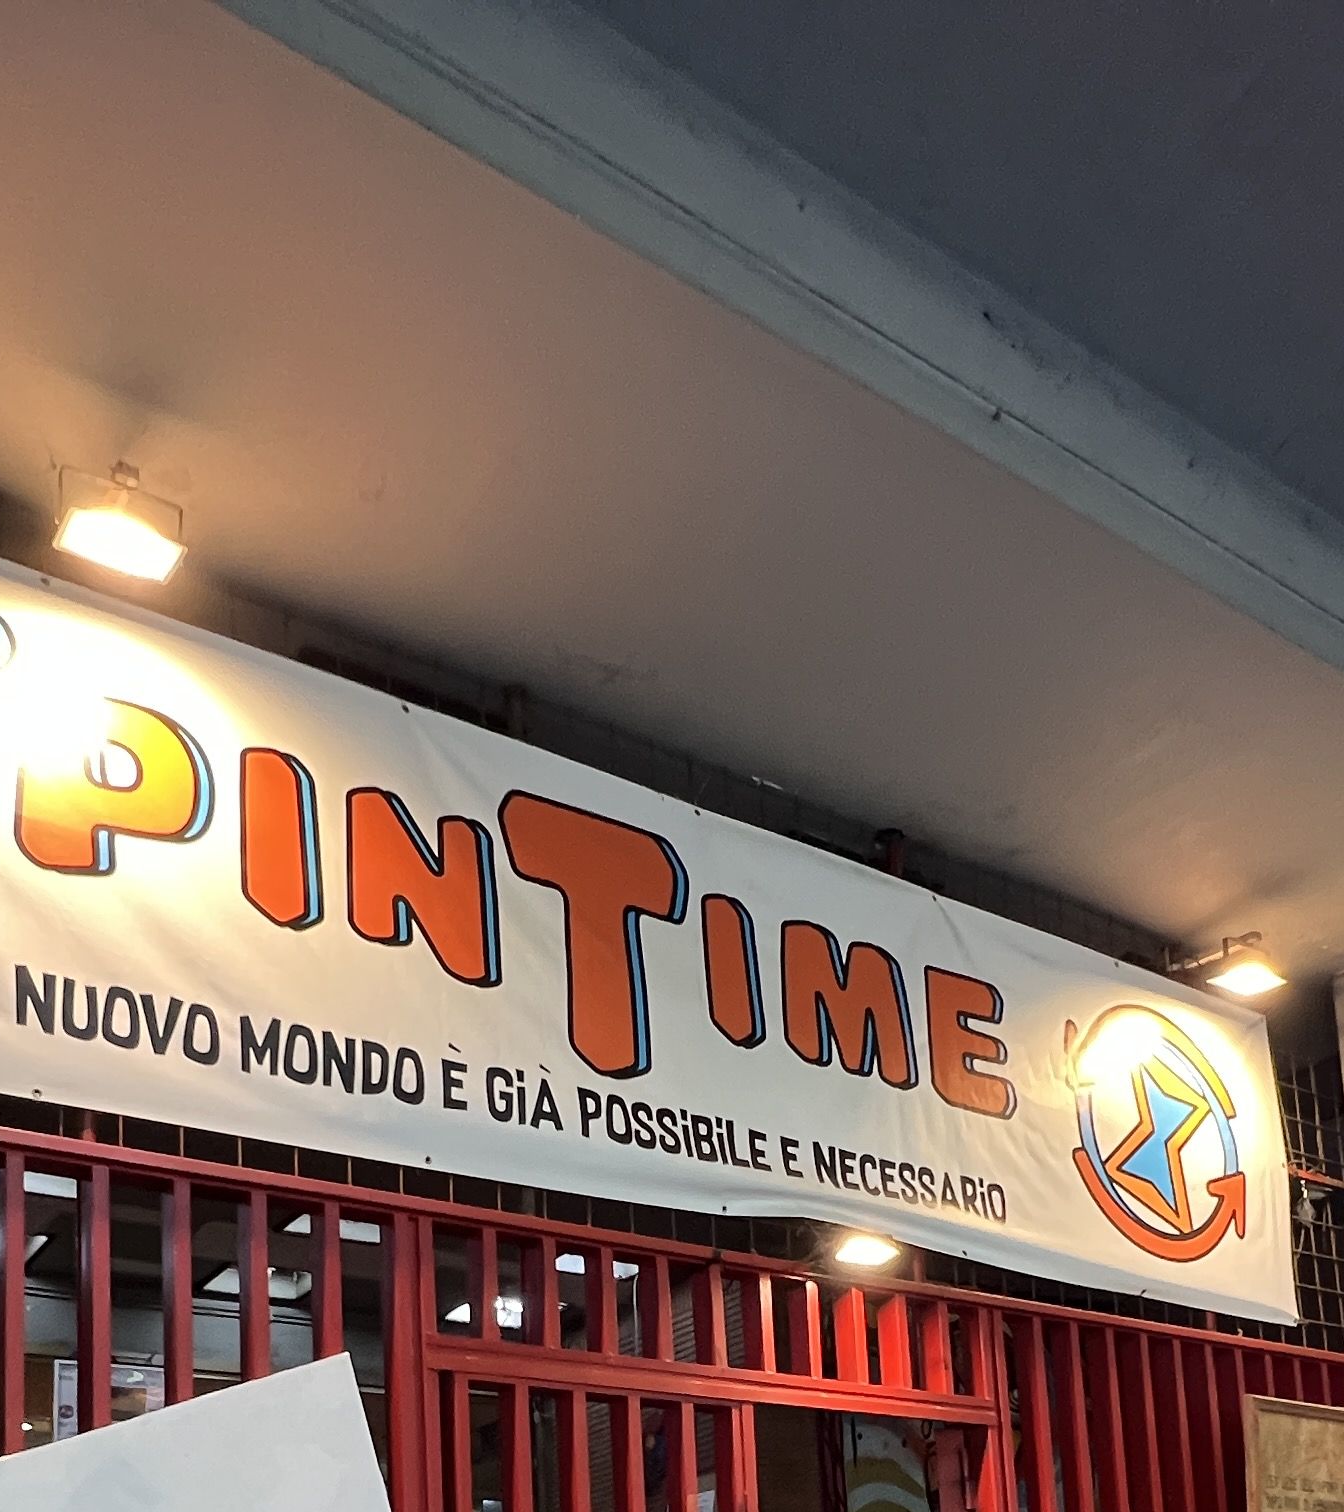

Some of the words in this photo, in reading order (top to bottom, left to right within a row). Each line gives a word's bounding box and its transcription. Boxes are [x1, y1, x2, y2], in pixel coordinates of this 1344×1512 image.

[15, 964, 221, 1066] NUOVO
[239, 1015, 426, 1106] MONDO
[440, 1043, 468, 1112] È
[779, 1135, 806, 1179] E
